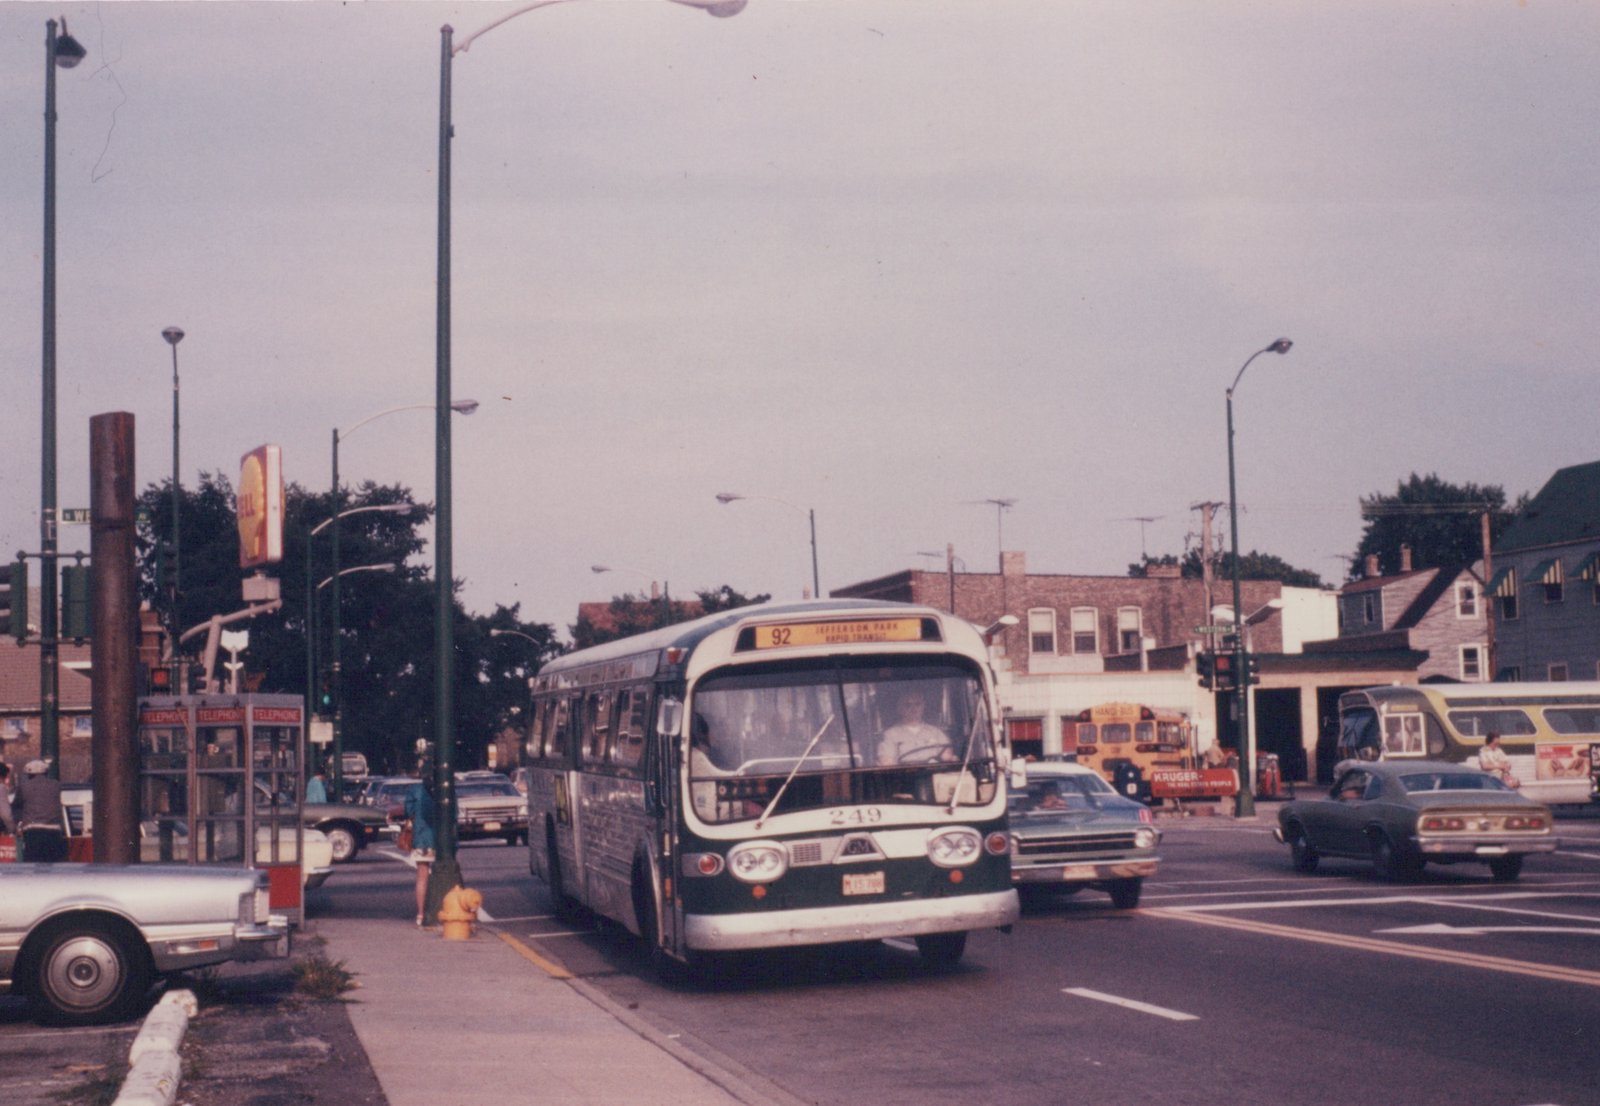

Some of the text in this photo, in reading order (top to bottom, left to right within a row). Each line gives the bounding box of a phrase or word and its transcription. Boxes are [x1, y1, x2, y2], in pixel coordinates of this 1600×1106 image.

[815, 621, 899, 635] JEFFERSON PARK
[771, 628, 792, 646] 92
[825, 632, 887, 643] RAPID TRANSIT
[144, 709, 188, 723] TELEPHONE
[254, 709, 299, 721] TELEPHONE
[829, 807, 882, 825] 249
[847, 840, 870, 854] GM
